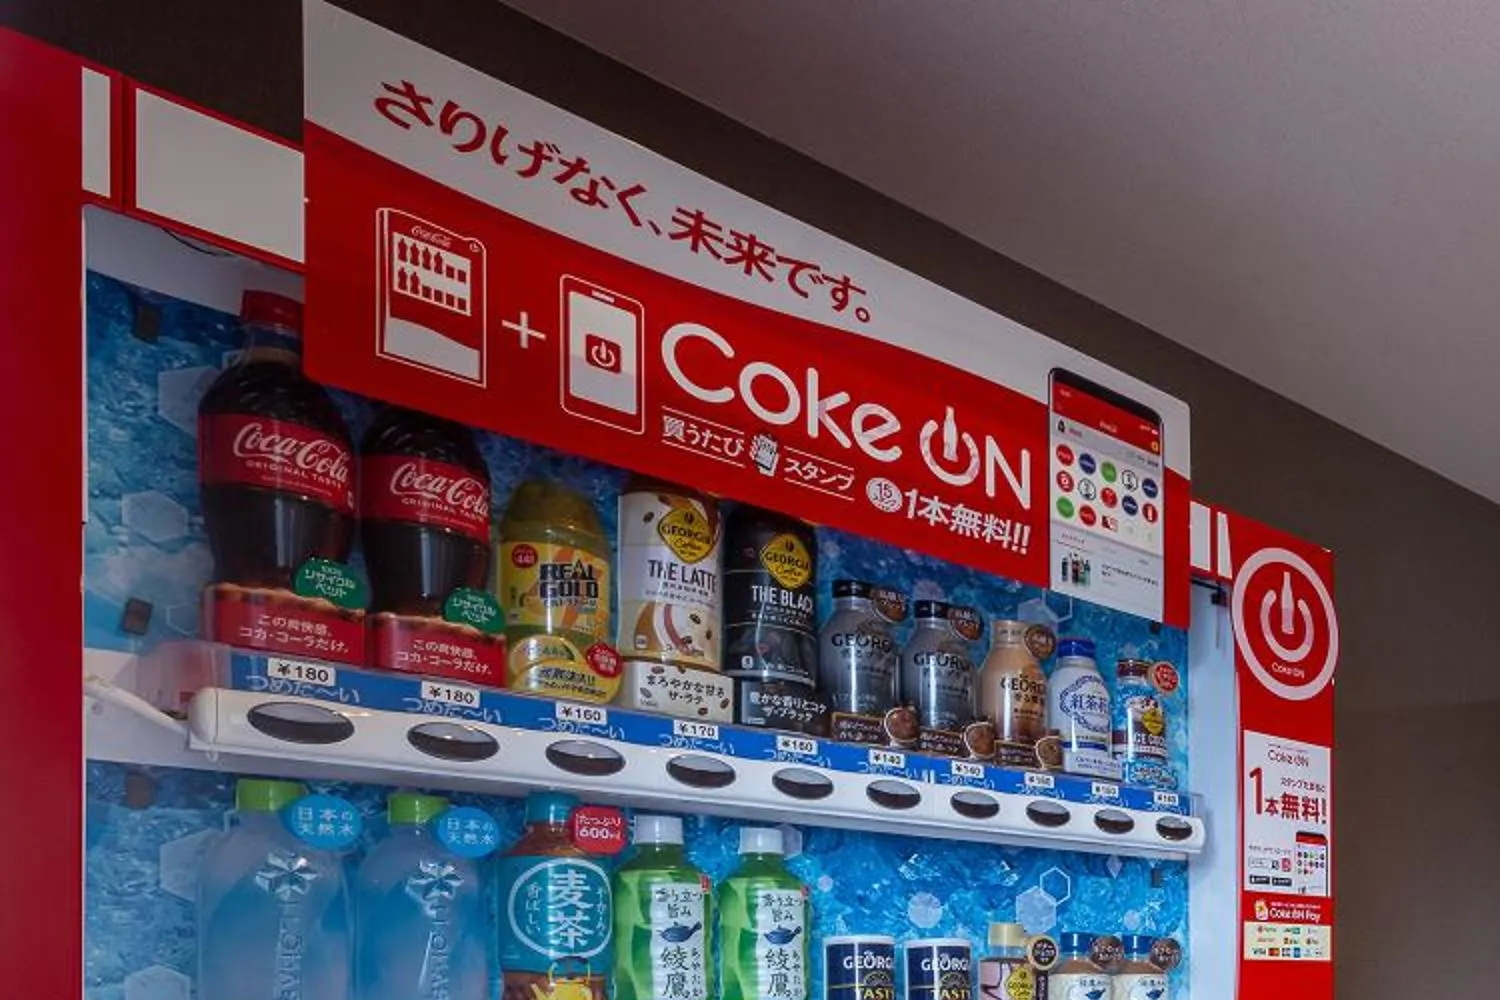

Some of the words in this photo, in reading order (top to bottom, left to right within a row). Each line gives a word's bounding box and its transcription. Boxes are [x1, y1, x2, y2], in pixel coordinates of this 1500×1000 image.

[374, 79, 871, 324] さりげなく、未来です。
[660, 323, 904, 463] Coke
[661, 413, 745, 458] 買うたび
[784, 459, 855, 492] スタンプ
[304, 569, 357, 590] リサイクル
[539, 559, 595, 581] REAL
[647, 560, 677, 581] THE
[681, 566, 717, 593] LATTE
[315, 581, 347, 598] ペット
[539, 581, 599, 599] GOLD
[751, 585, 777, 603] THE
[277, 663, 329, 683] ¥180
[428, 686, 475, 704] ¥180
[1249, 767, 1327, 825] 1本無料!
[298, 806, 354, 822] 日本の
[297, 821, 355, 837] 天然水
[447, 818, 494, 832] 日本の
[447, 832, 496, 845] 天然水
[548, 868, 593, 950] 麦茶
[661, 945, 690, 1000] 綾鷹
[764, 948, 791, 998] 綾鷹
